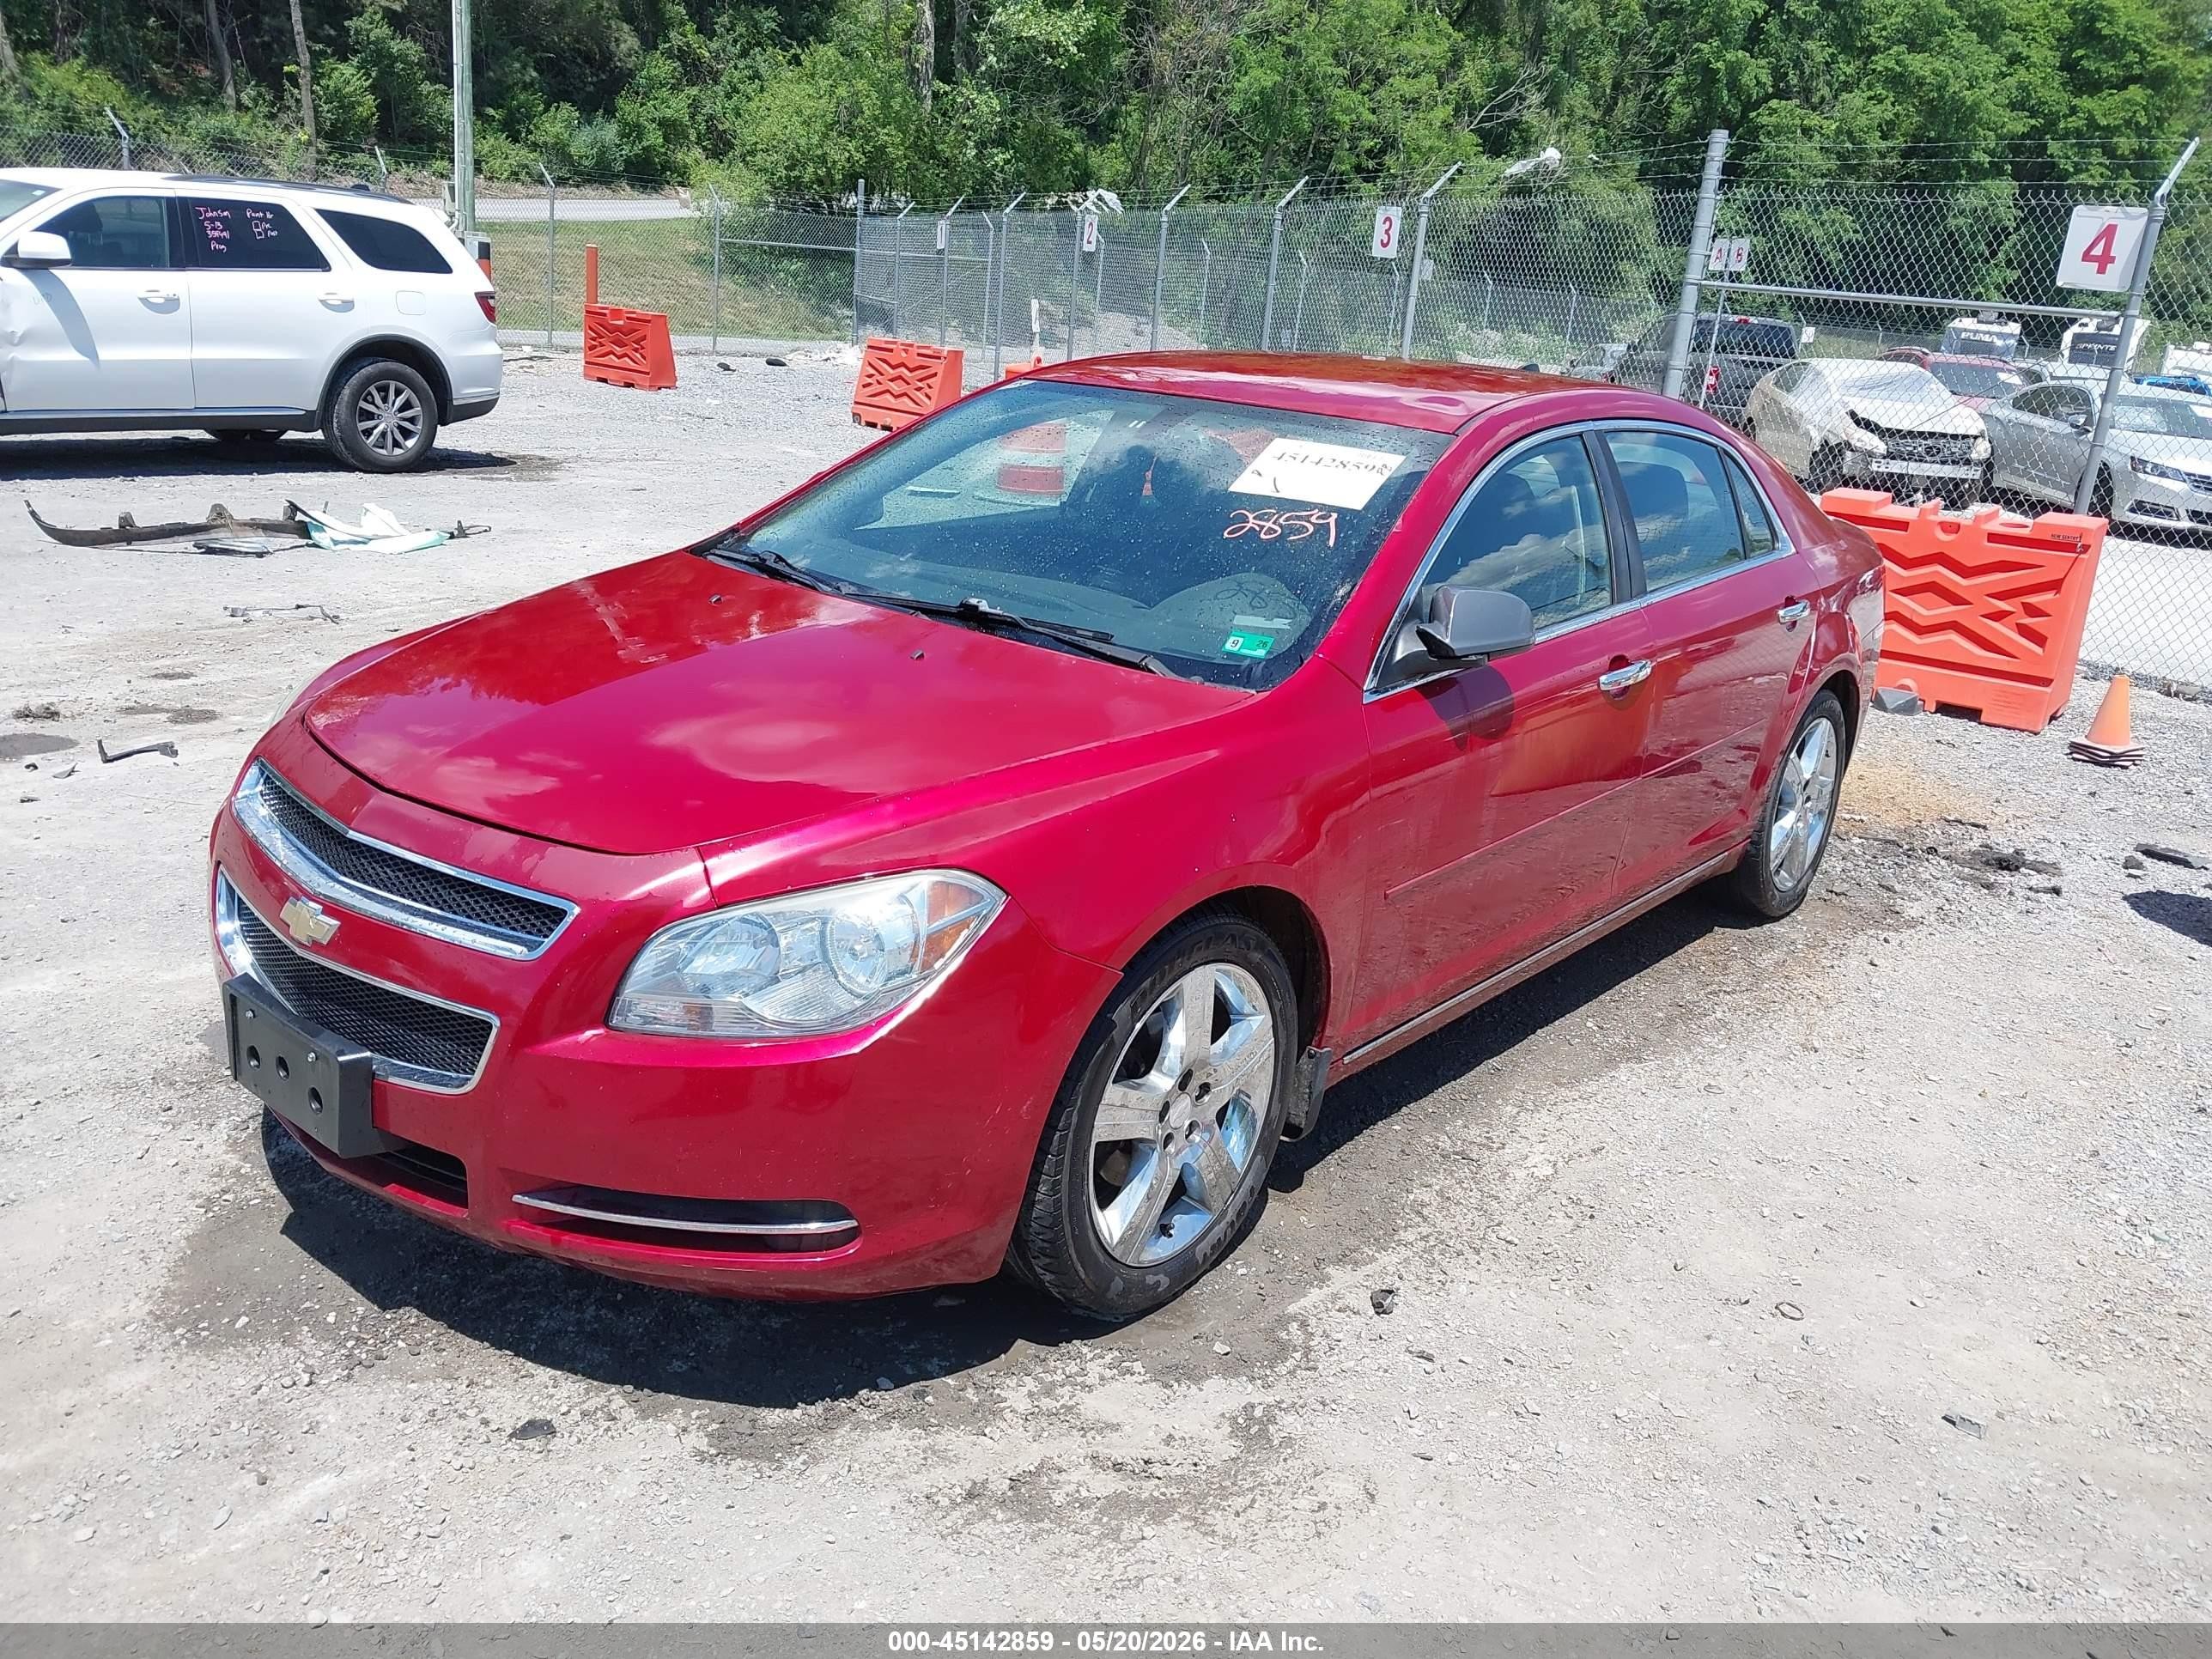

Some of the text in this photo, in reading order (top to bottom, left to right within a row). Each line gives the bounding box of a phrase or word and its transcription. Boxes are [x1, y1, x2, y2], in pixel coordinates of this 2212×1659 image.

[1085, 221, 1093, 245] 2
[1380, 216, 1393, 248] 3
[1714, 246, 1723, 263] A
[2081, 223, 2117, 275] 4
[1960, 331, 1998, 343] PUMA
[2075, 342, 2118, 351] SPRINTE
[1223, 508, 1338, 548] 2859
[1230, 639, 1268, 648] 9 26
